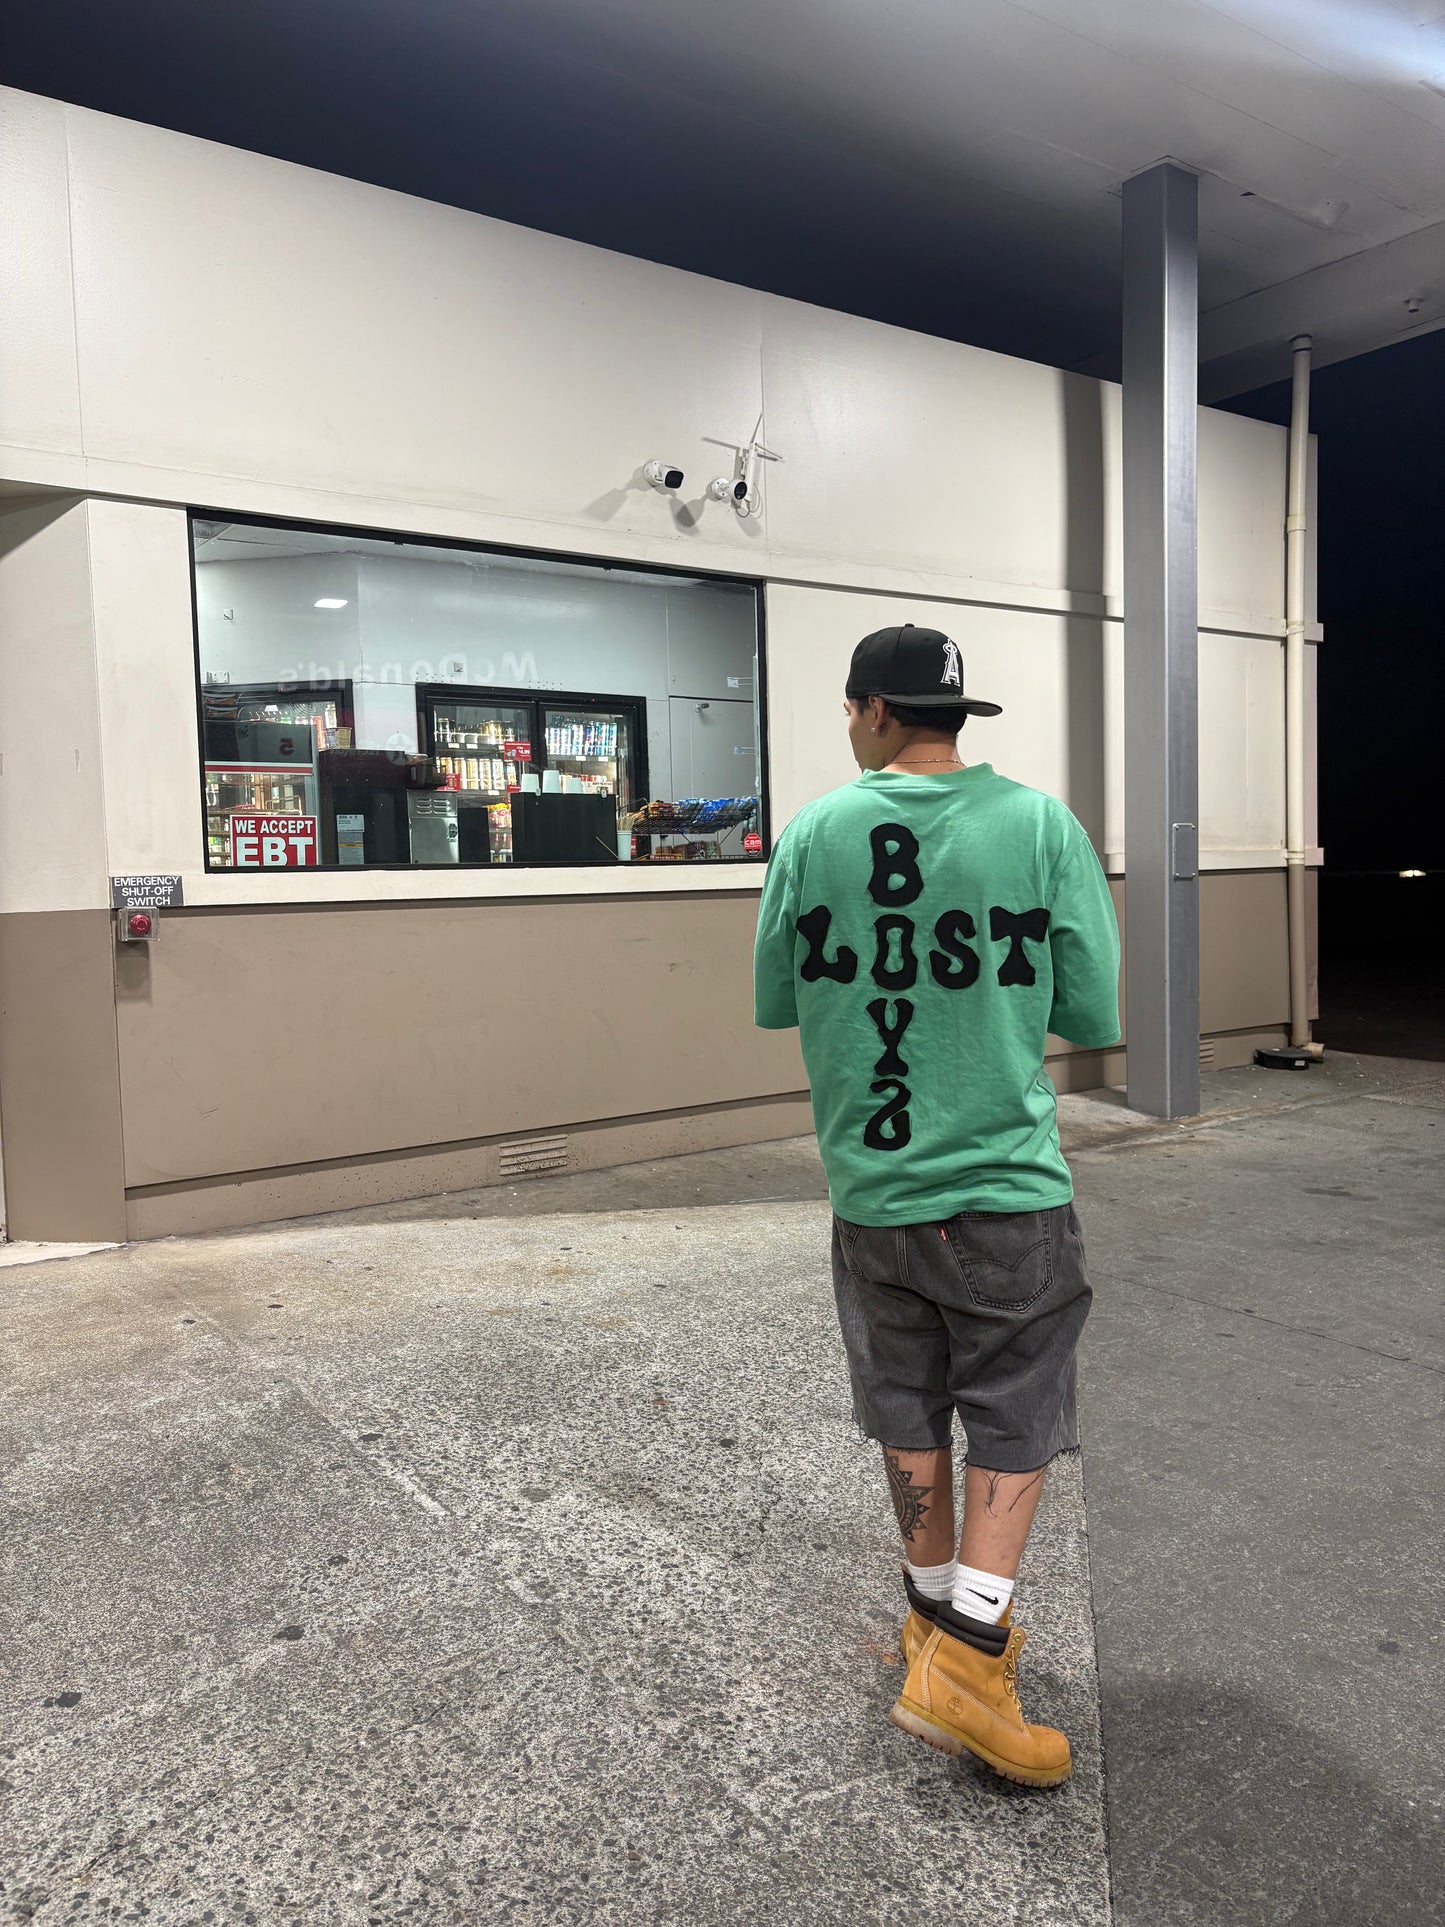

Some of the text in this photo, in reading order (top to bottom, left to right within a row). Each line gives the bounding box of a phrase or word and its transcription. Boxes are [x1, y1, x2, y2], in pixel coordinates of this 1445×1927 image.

[940, 638, 961, 687] A
[234, 819, 314, 834] WE ACCEPT
[236, 836, 314, 867] EBT
[114, 876, 179, 887] EMERGENCY
[121, 886, 174, 897] SHUT-OFF
[126, 896, 171, 907] SWITCH
[795, 904, 1051, 991] LOST
